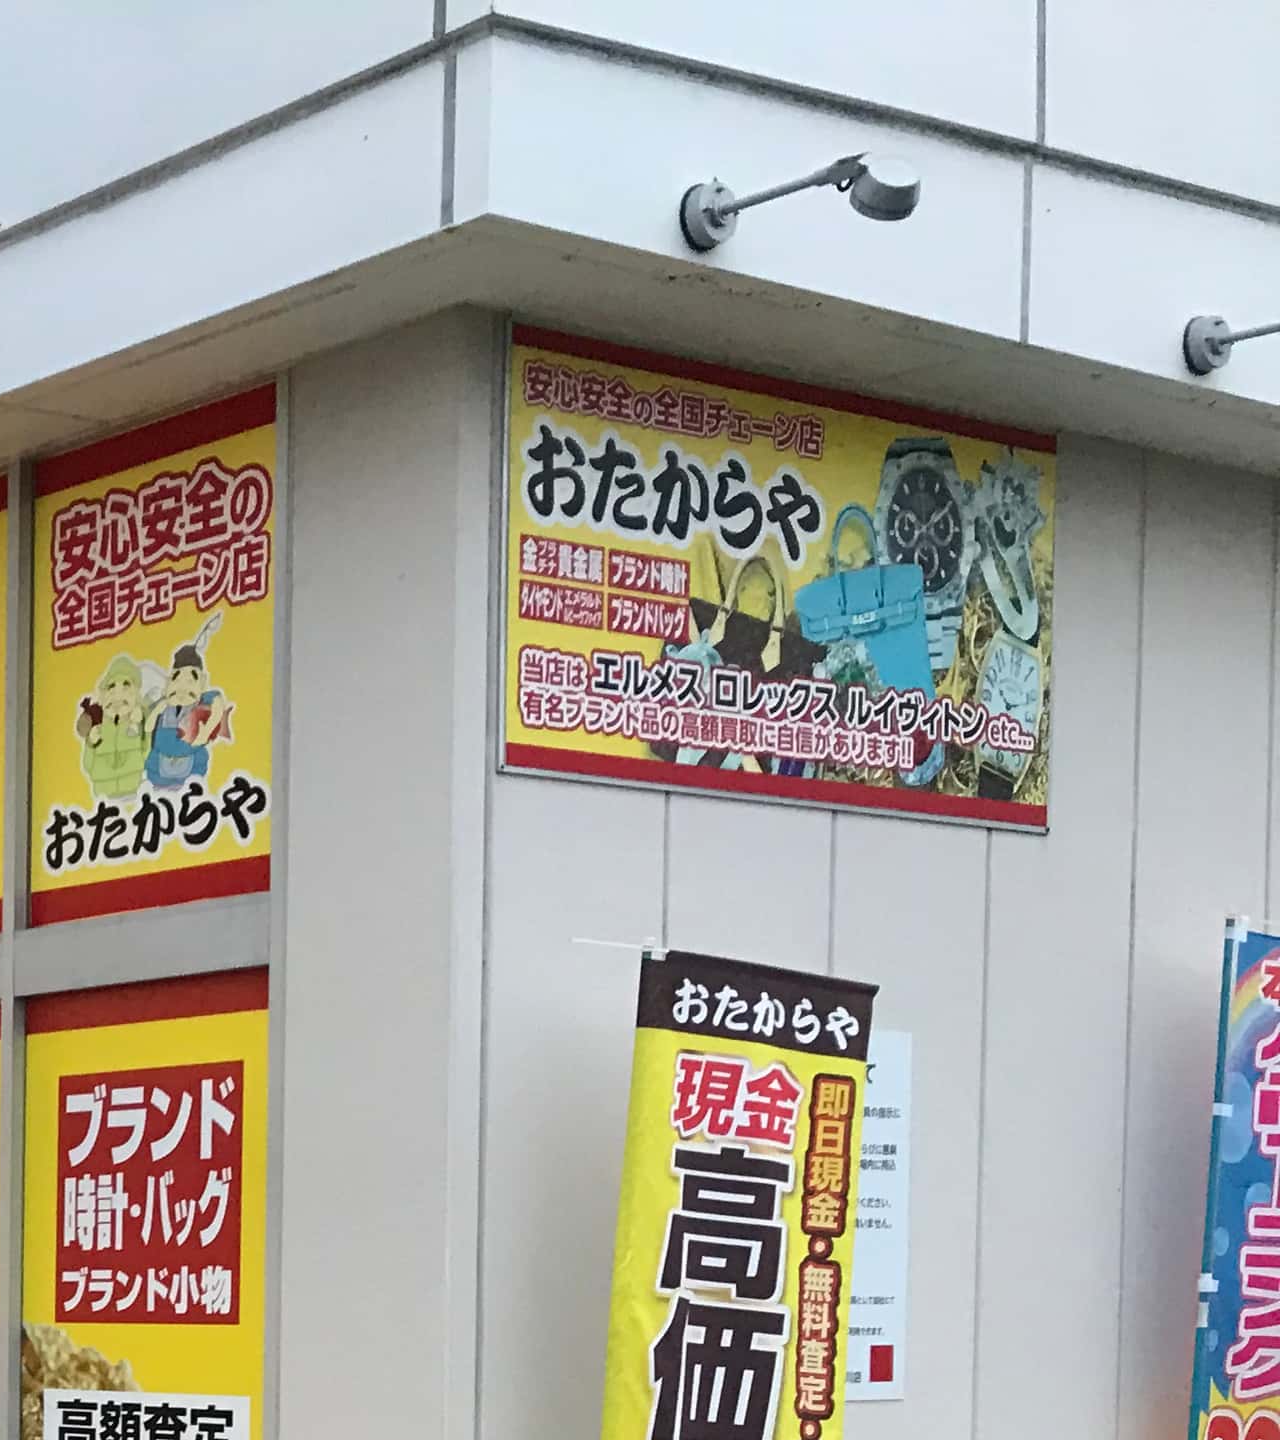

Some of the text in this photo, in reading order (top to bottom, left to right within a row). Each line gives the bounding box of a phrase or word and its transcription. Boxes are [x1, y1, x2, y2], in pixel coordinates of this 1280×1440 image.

[526, 361, 824, 459] 安心安全の全国チェーン店
[54, 459, 271, 589] 安心安全の
[528, 424, 820, 561] おたからや
[54, 535, 268, 647] 全国チェーン店
[522, 537, 538, 573] 金
[523, 651, 586, 688] 当店は
[593, 655, 704, 707] エルメス
[715, 672, 839, 724] ロレックス
[844, 687, 985, 742] ルイヴィトン
[45, 776, 268, 870] おたからや
[672, 978, 859, 1050] おたからや
[66, 1076, 235, 1168] ブランド
[673, 1058, 801, 1144] 現金
[63, 1166, 232, 1251] 時計・バッグ
[61, 1265, 232, 1314] ブランド小物
